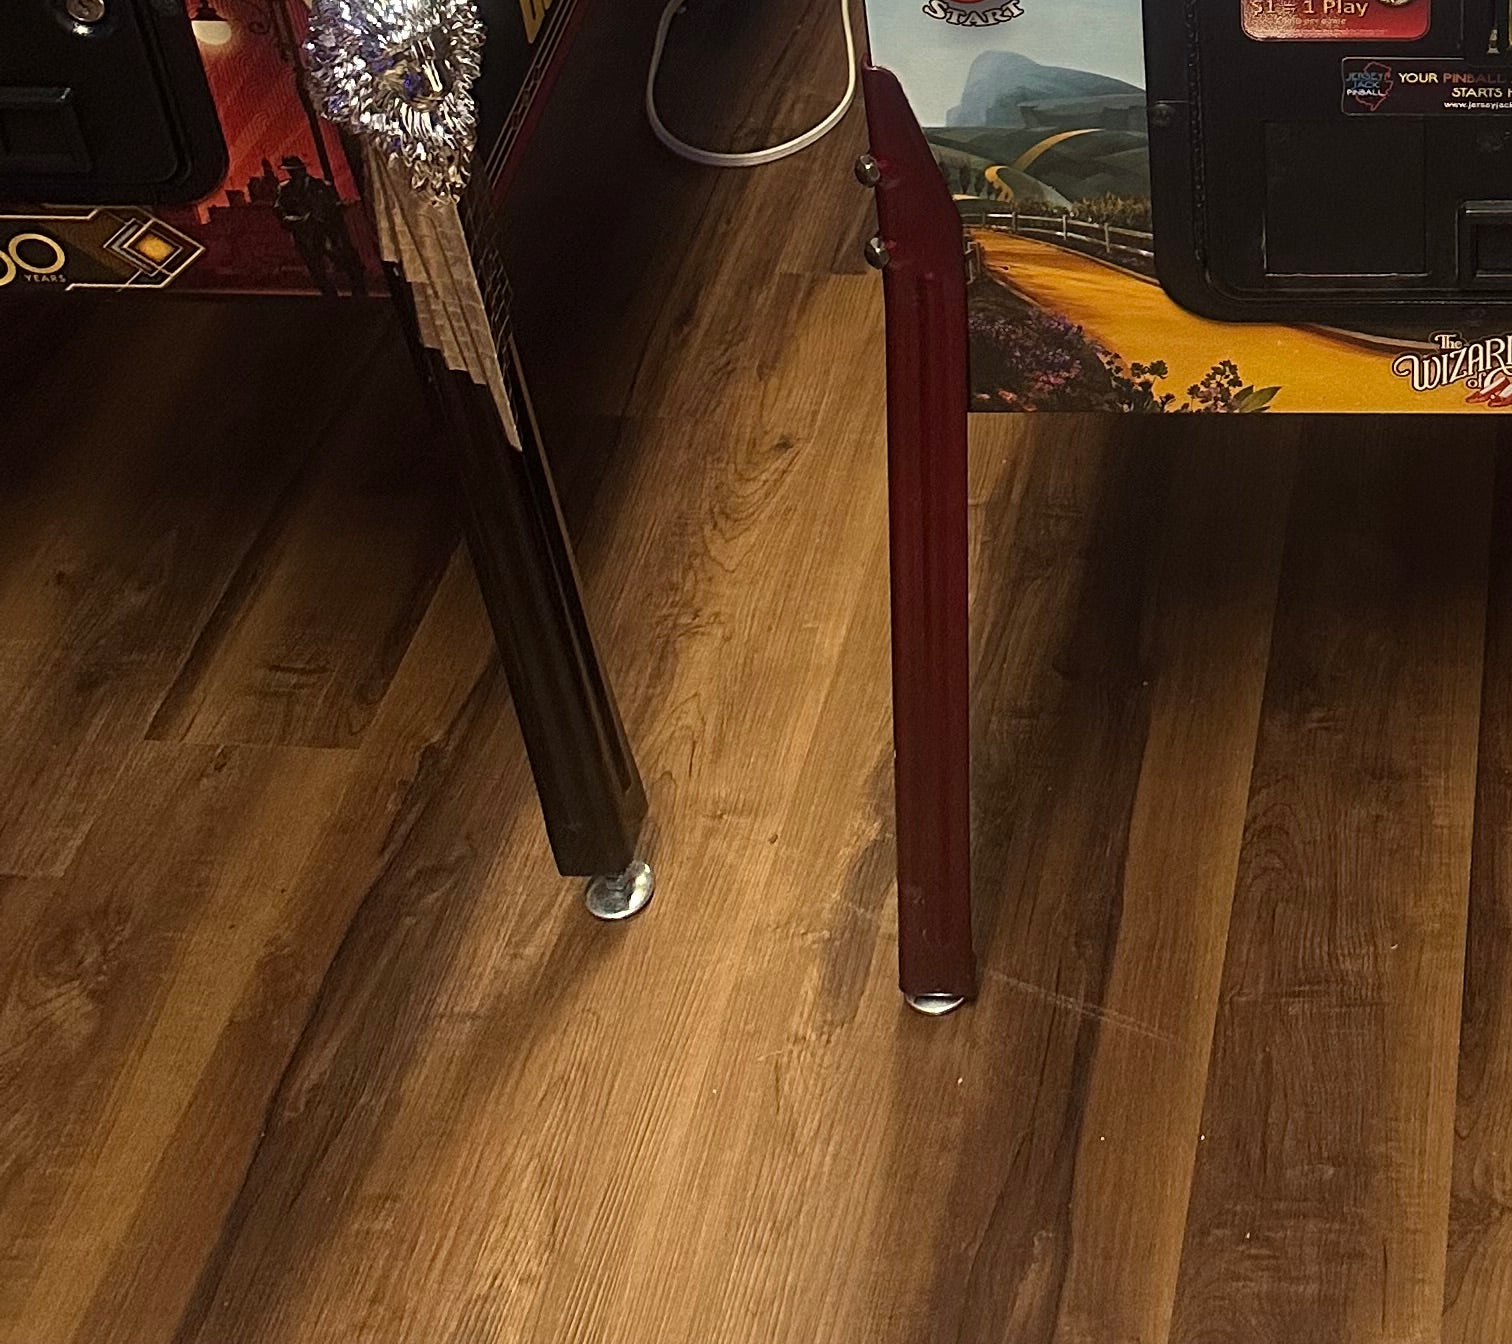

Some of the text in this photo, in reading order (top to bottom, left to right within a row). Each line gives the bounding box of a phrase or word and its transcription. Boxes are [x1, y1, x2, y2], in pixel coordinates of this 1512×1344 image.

[1346, 71, 1384, 84] JERSEY
[1398, 73, 1439, 85] YOUR
[1443, 73, 1506, 85] PINBALL
[1351, 81, 1382, 91] JACK
[1346, 88, 1386, 97] PINBALL
[1451, 87, 1503, 99] STARTS
[23, 273, 67, 284] YEARS
[1434, 333, 1463, 350] The
[1467, 371, 1486, 389] of
